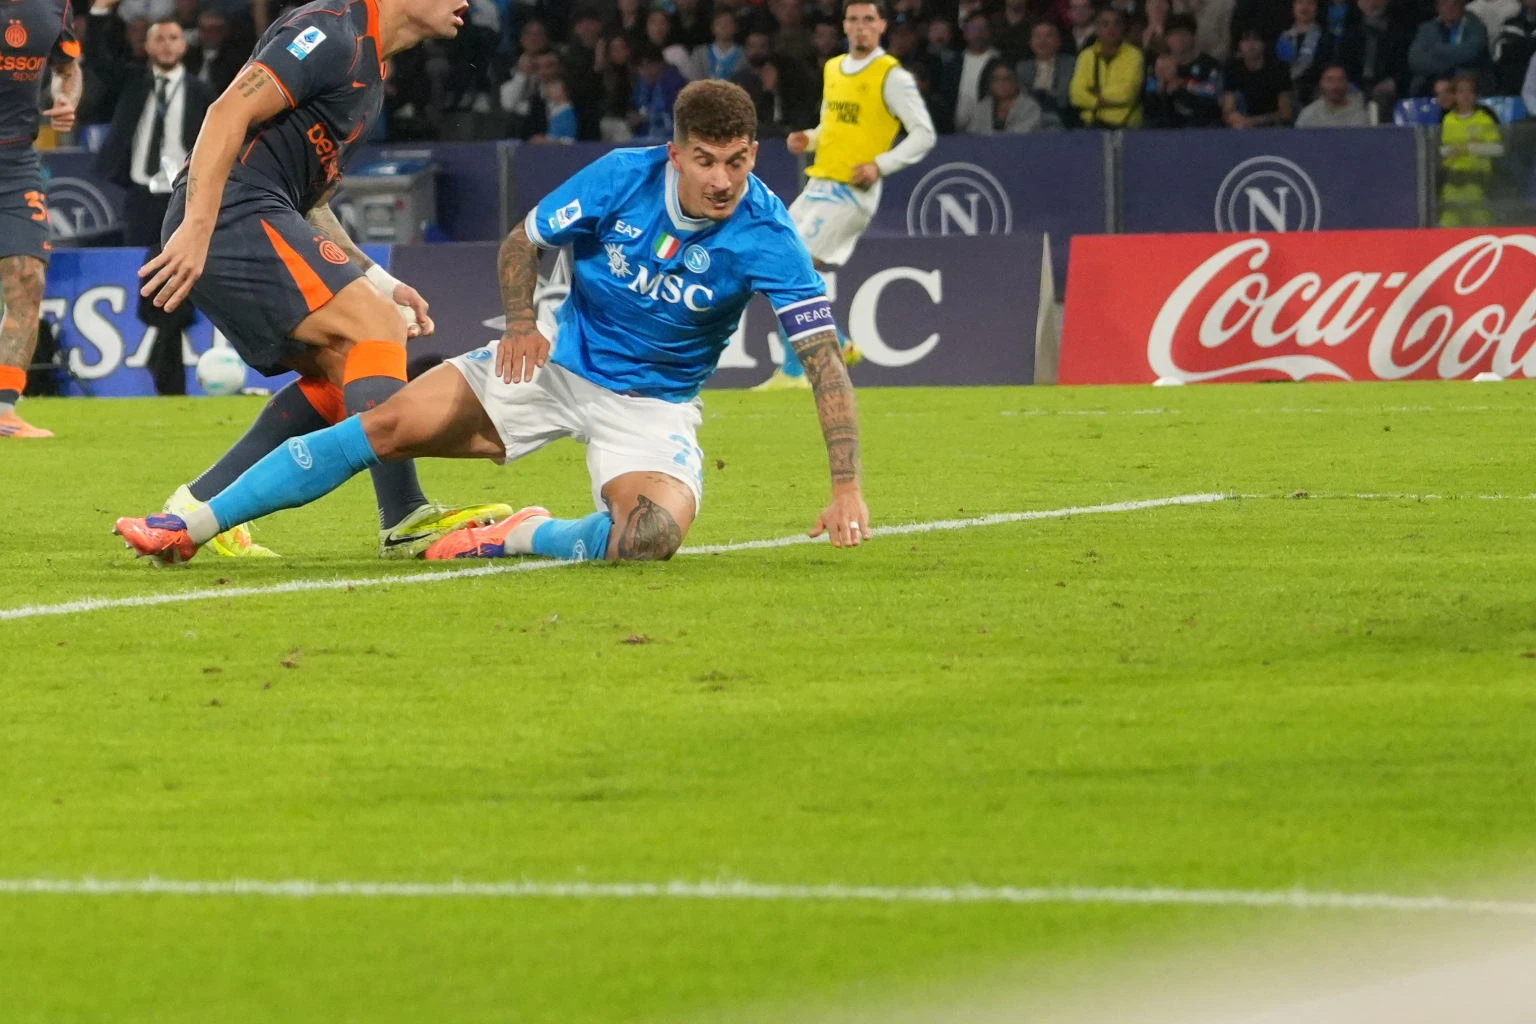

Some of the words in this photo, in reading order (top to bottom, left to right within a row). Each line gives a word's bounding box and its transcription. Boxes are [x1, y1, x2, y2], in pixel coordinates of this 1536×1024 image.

[24, 190, 50, 224] 3
[615, 219, 643, 239] EA7
[935, 193, 981, 237] N
[1244, 186, 1290, 233] N
[628, 264, 713, 312] MSC
[1147, 234, 1536, 382] Coca-Col
